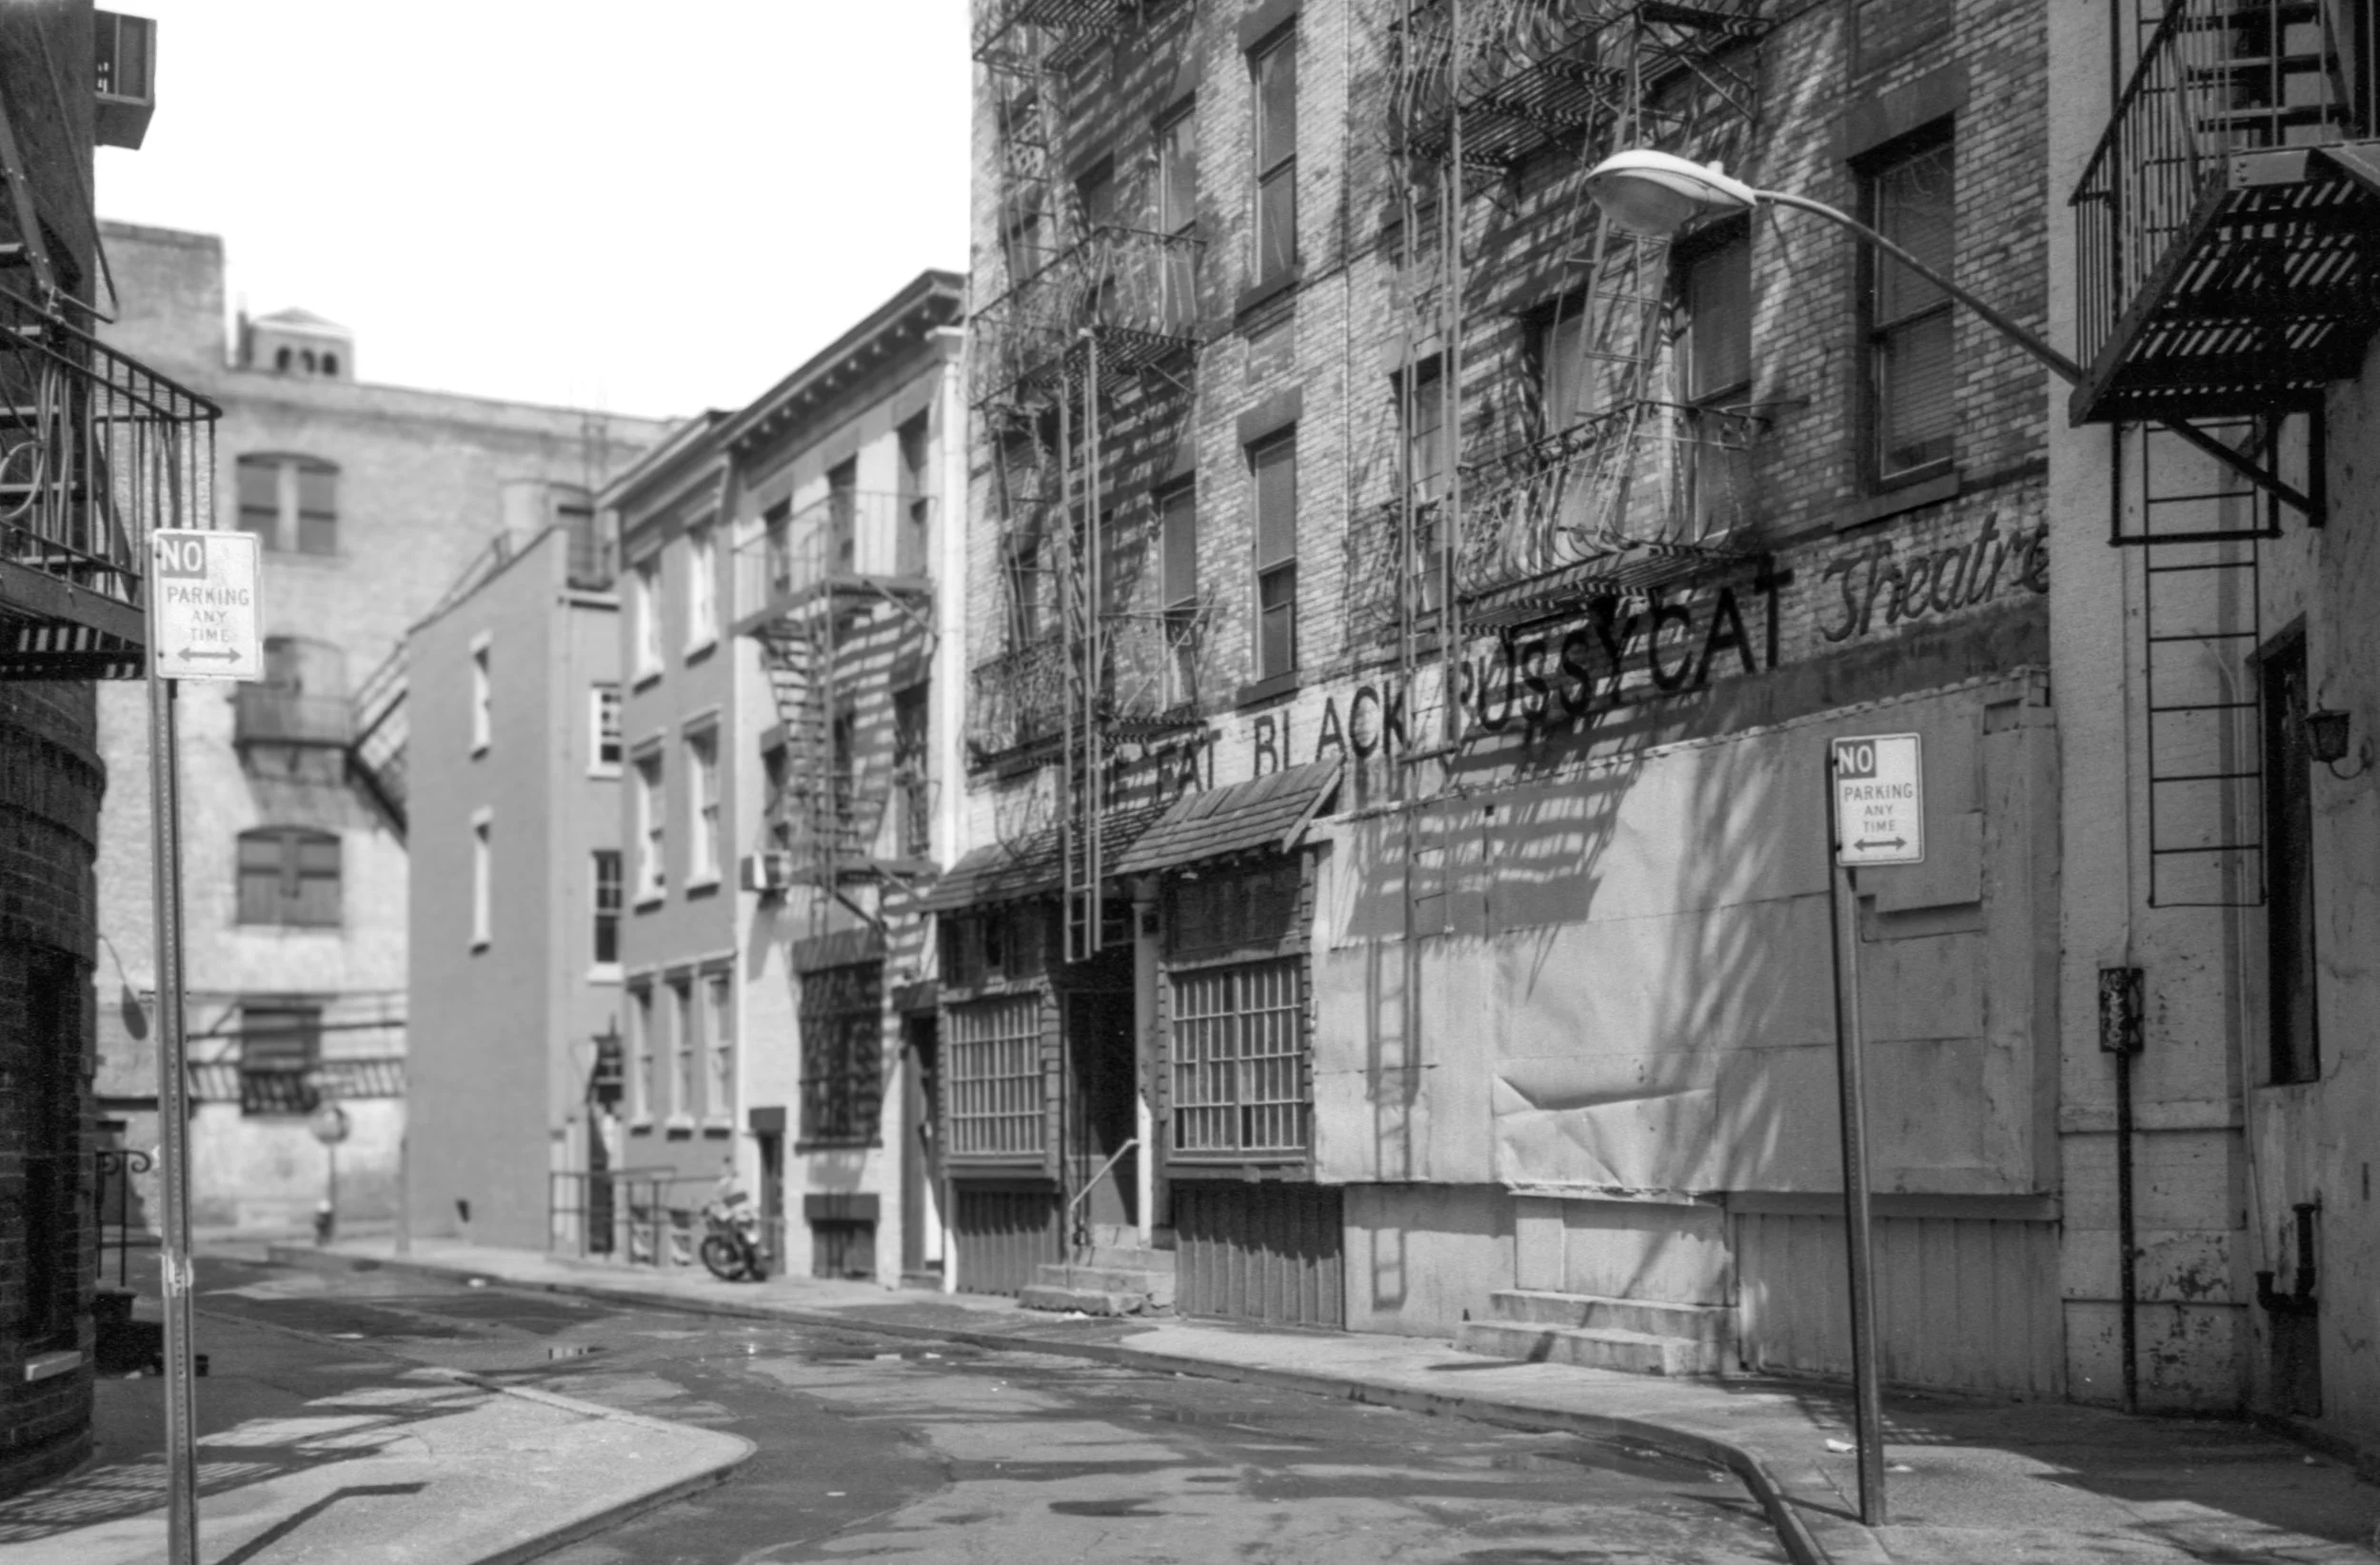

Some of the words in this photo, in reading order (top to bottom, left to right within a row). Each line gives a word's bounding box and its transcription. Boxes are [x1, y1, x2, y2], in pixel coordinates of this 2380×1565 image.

[160, 538, 203, 572] NO
[1819, 511, 2049, 643] Theatre
[167, 584, 250, 606] PARKING
[192, 608, 228, 624] ANY
[189, 626, 229, 644] TIME
[1156, 727, 1223, 807] FAT
[1837, 744, 1874, 774] NO
[1844, 782, 1914, 802] PARKING
[1864, 803, 1894, 817] ANY
[1862, 819, 1896, 834] TIME
